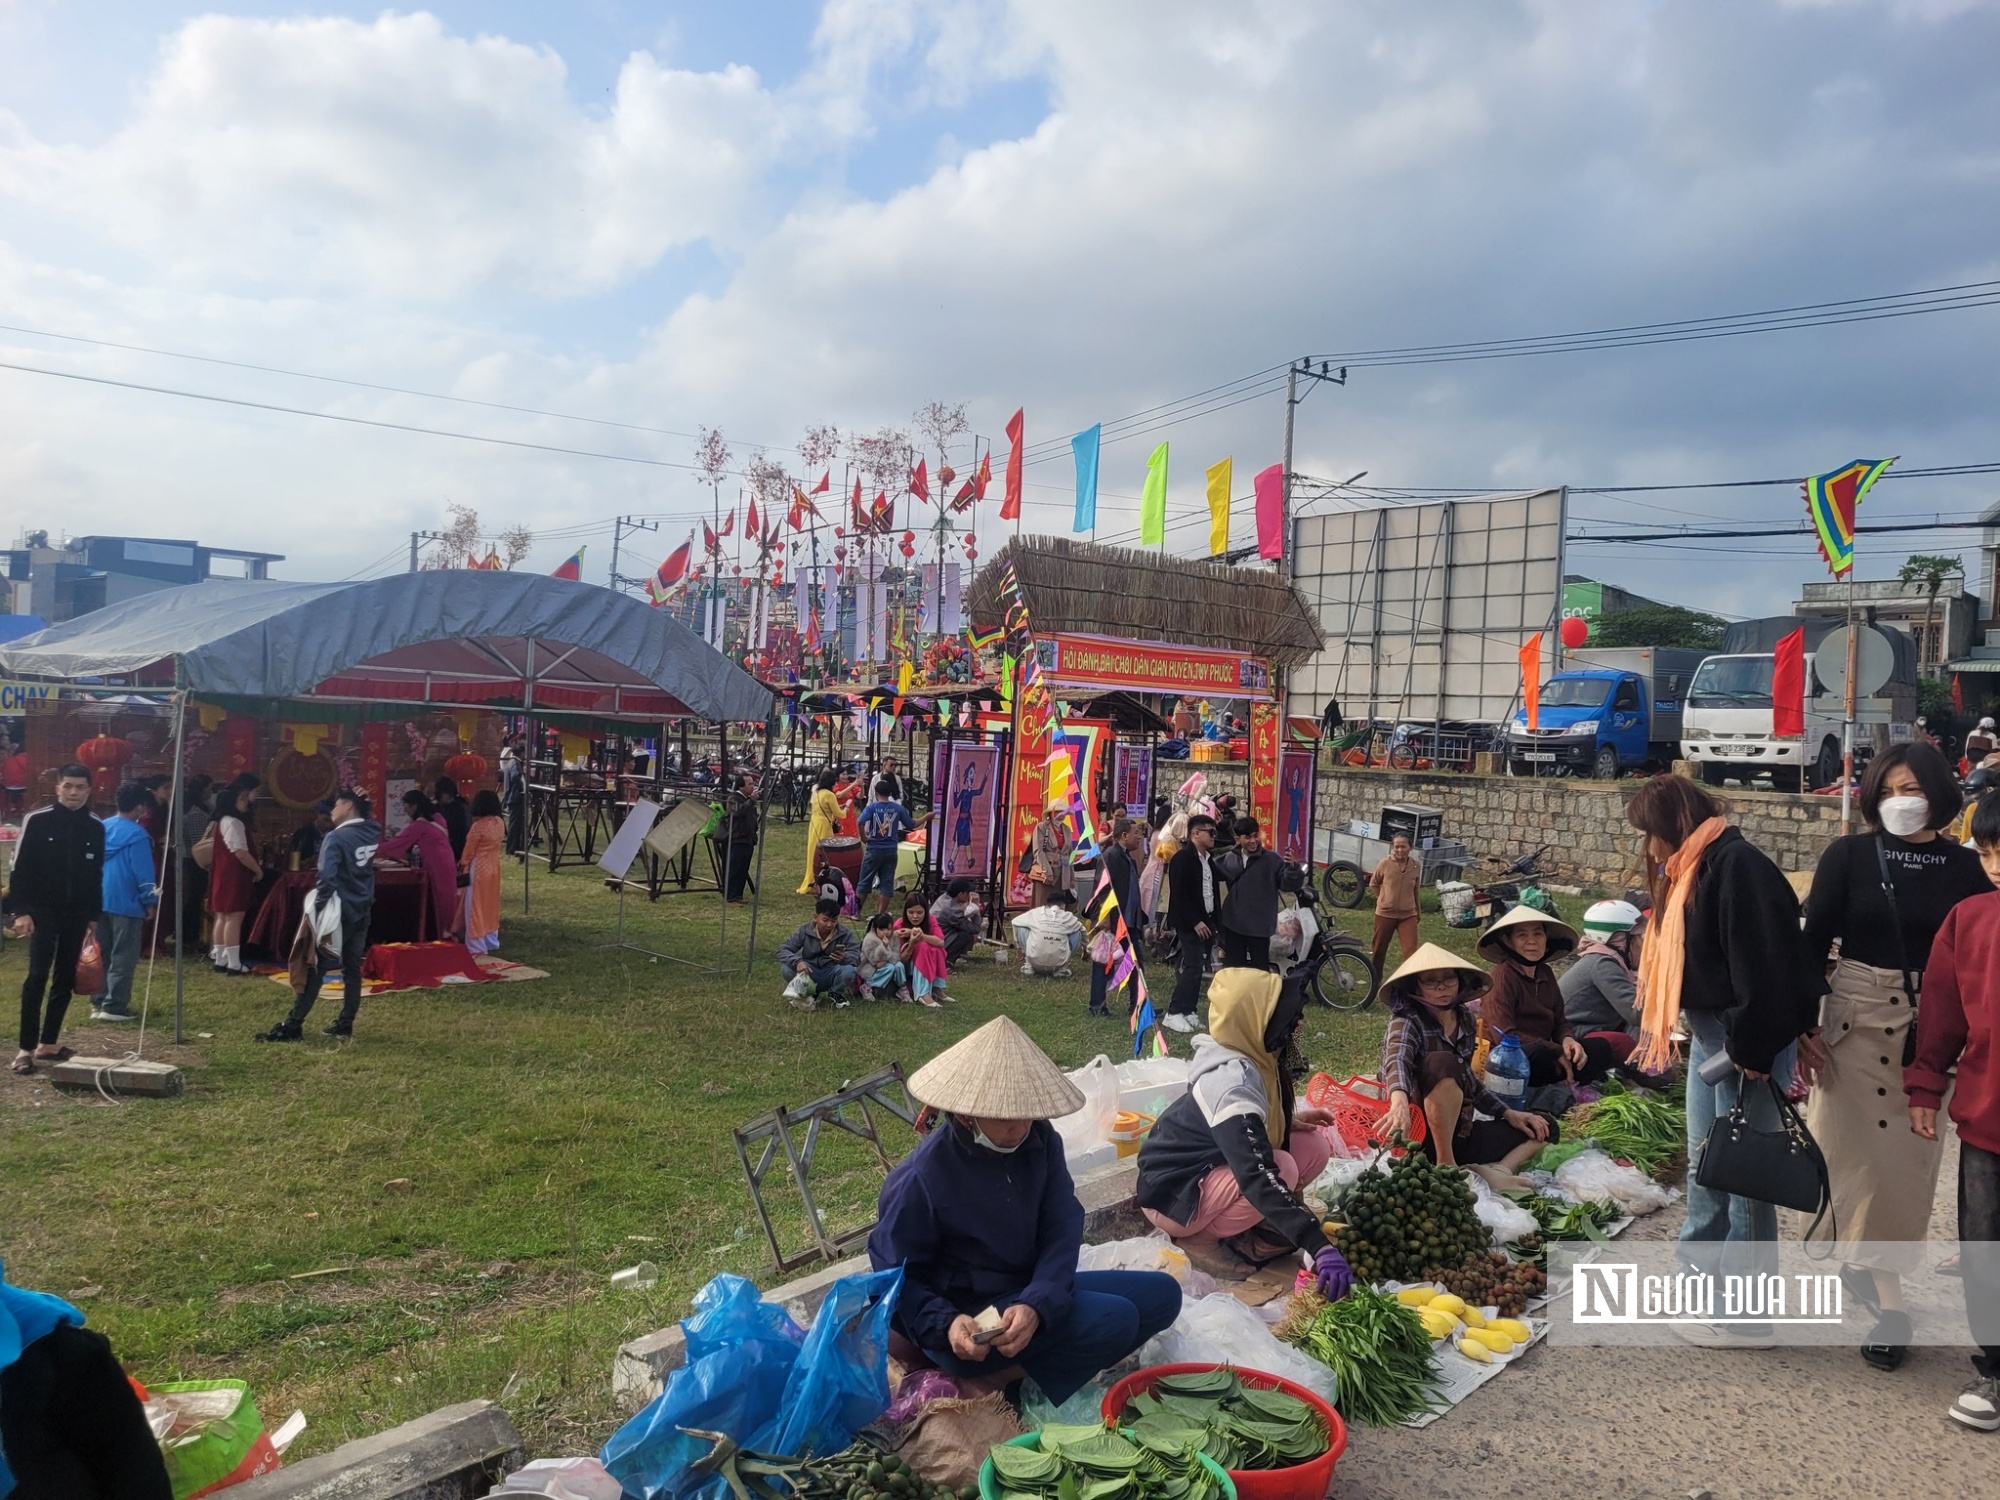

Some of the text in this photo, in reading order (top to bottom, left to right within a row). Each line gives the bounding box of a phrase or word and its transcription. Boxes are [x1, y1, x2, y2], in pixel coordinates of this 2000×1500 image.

[1063, 645, 1076, 673] HỘI
[1078, 647, 1099, 671] ĐÁNH
[1133, 654, 1150, 676] DÂN
[1150, 658, 1168, 678] GIAN
[1168, 657, 1194, 683] HUYỆN
[1209, 660, 1234, 683] PHƯỚC
[1021, 713, 1046, 737] Chú
[1884, 850, 1947, 864] GIVENCHY
